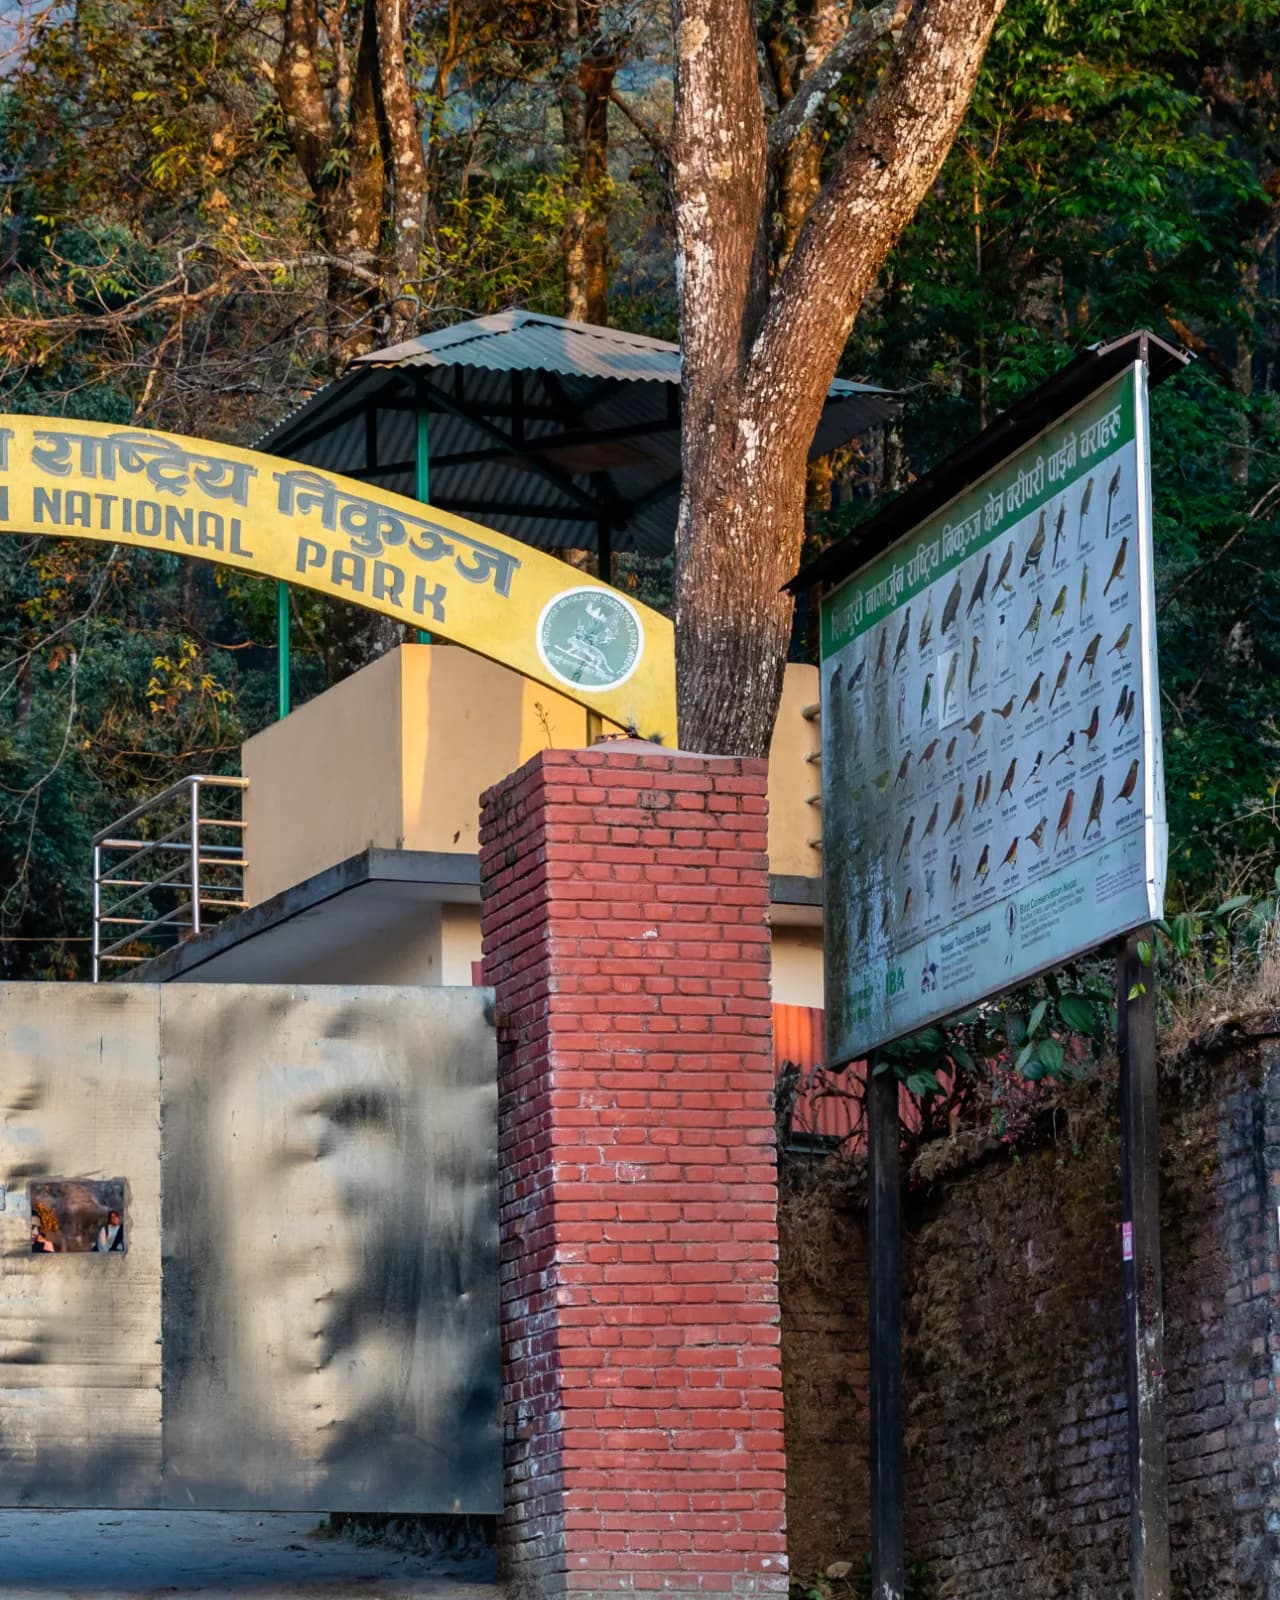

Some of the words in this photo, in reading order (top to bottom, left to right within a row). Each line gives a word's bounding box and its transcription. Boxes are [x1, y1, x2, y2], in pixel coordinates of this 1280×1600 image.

[32, 430, 258, 505] राष्ट्रिय
[273, 470, 520, 599] निकुञ्ज
[33, 488, 254, 558] NATIONAL
[296, 536, 448, 623] PARK
[943, 510, 981, 557] निकुञ्ज
[984, 492, 1004, 532] क्षेत्र
[1007, 456, 1045, 512] वरीपरी
